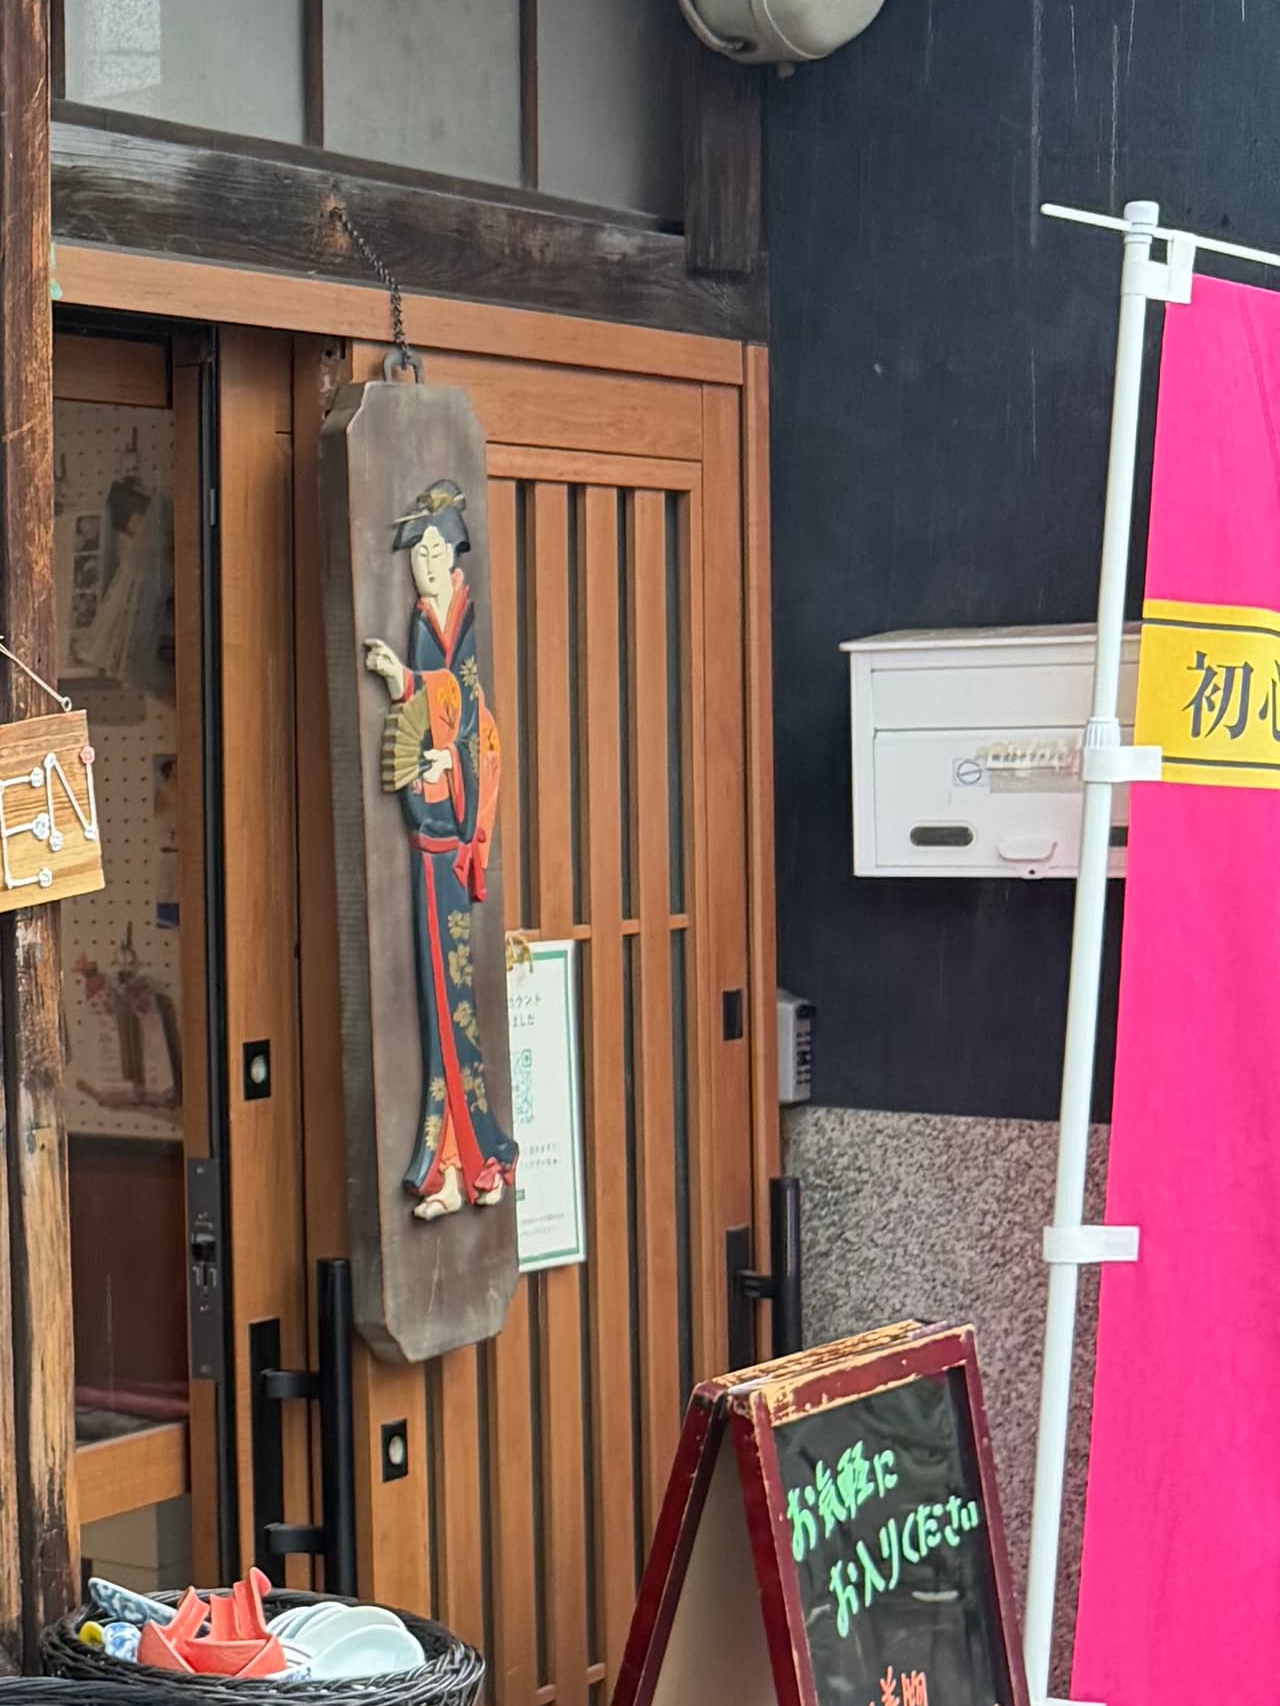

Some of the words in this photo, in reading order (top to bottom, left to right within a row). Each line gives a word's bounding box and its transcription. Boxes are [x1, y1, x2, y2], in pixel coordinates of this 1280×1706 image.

[787, 1440, 899, 1563] お気軽に
[829, 1495, 979, 1638] お入りください
